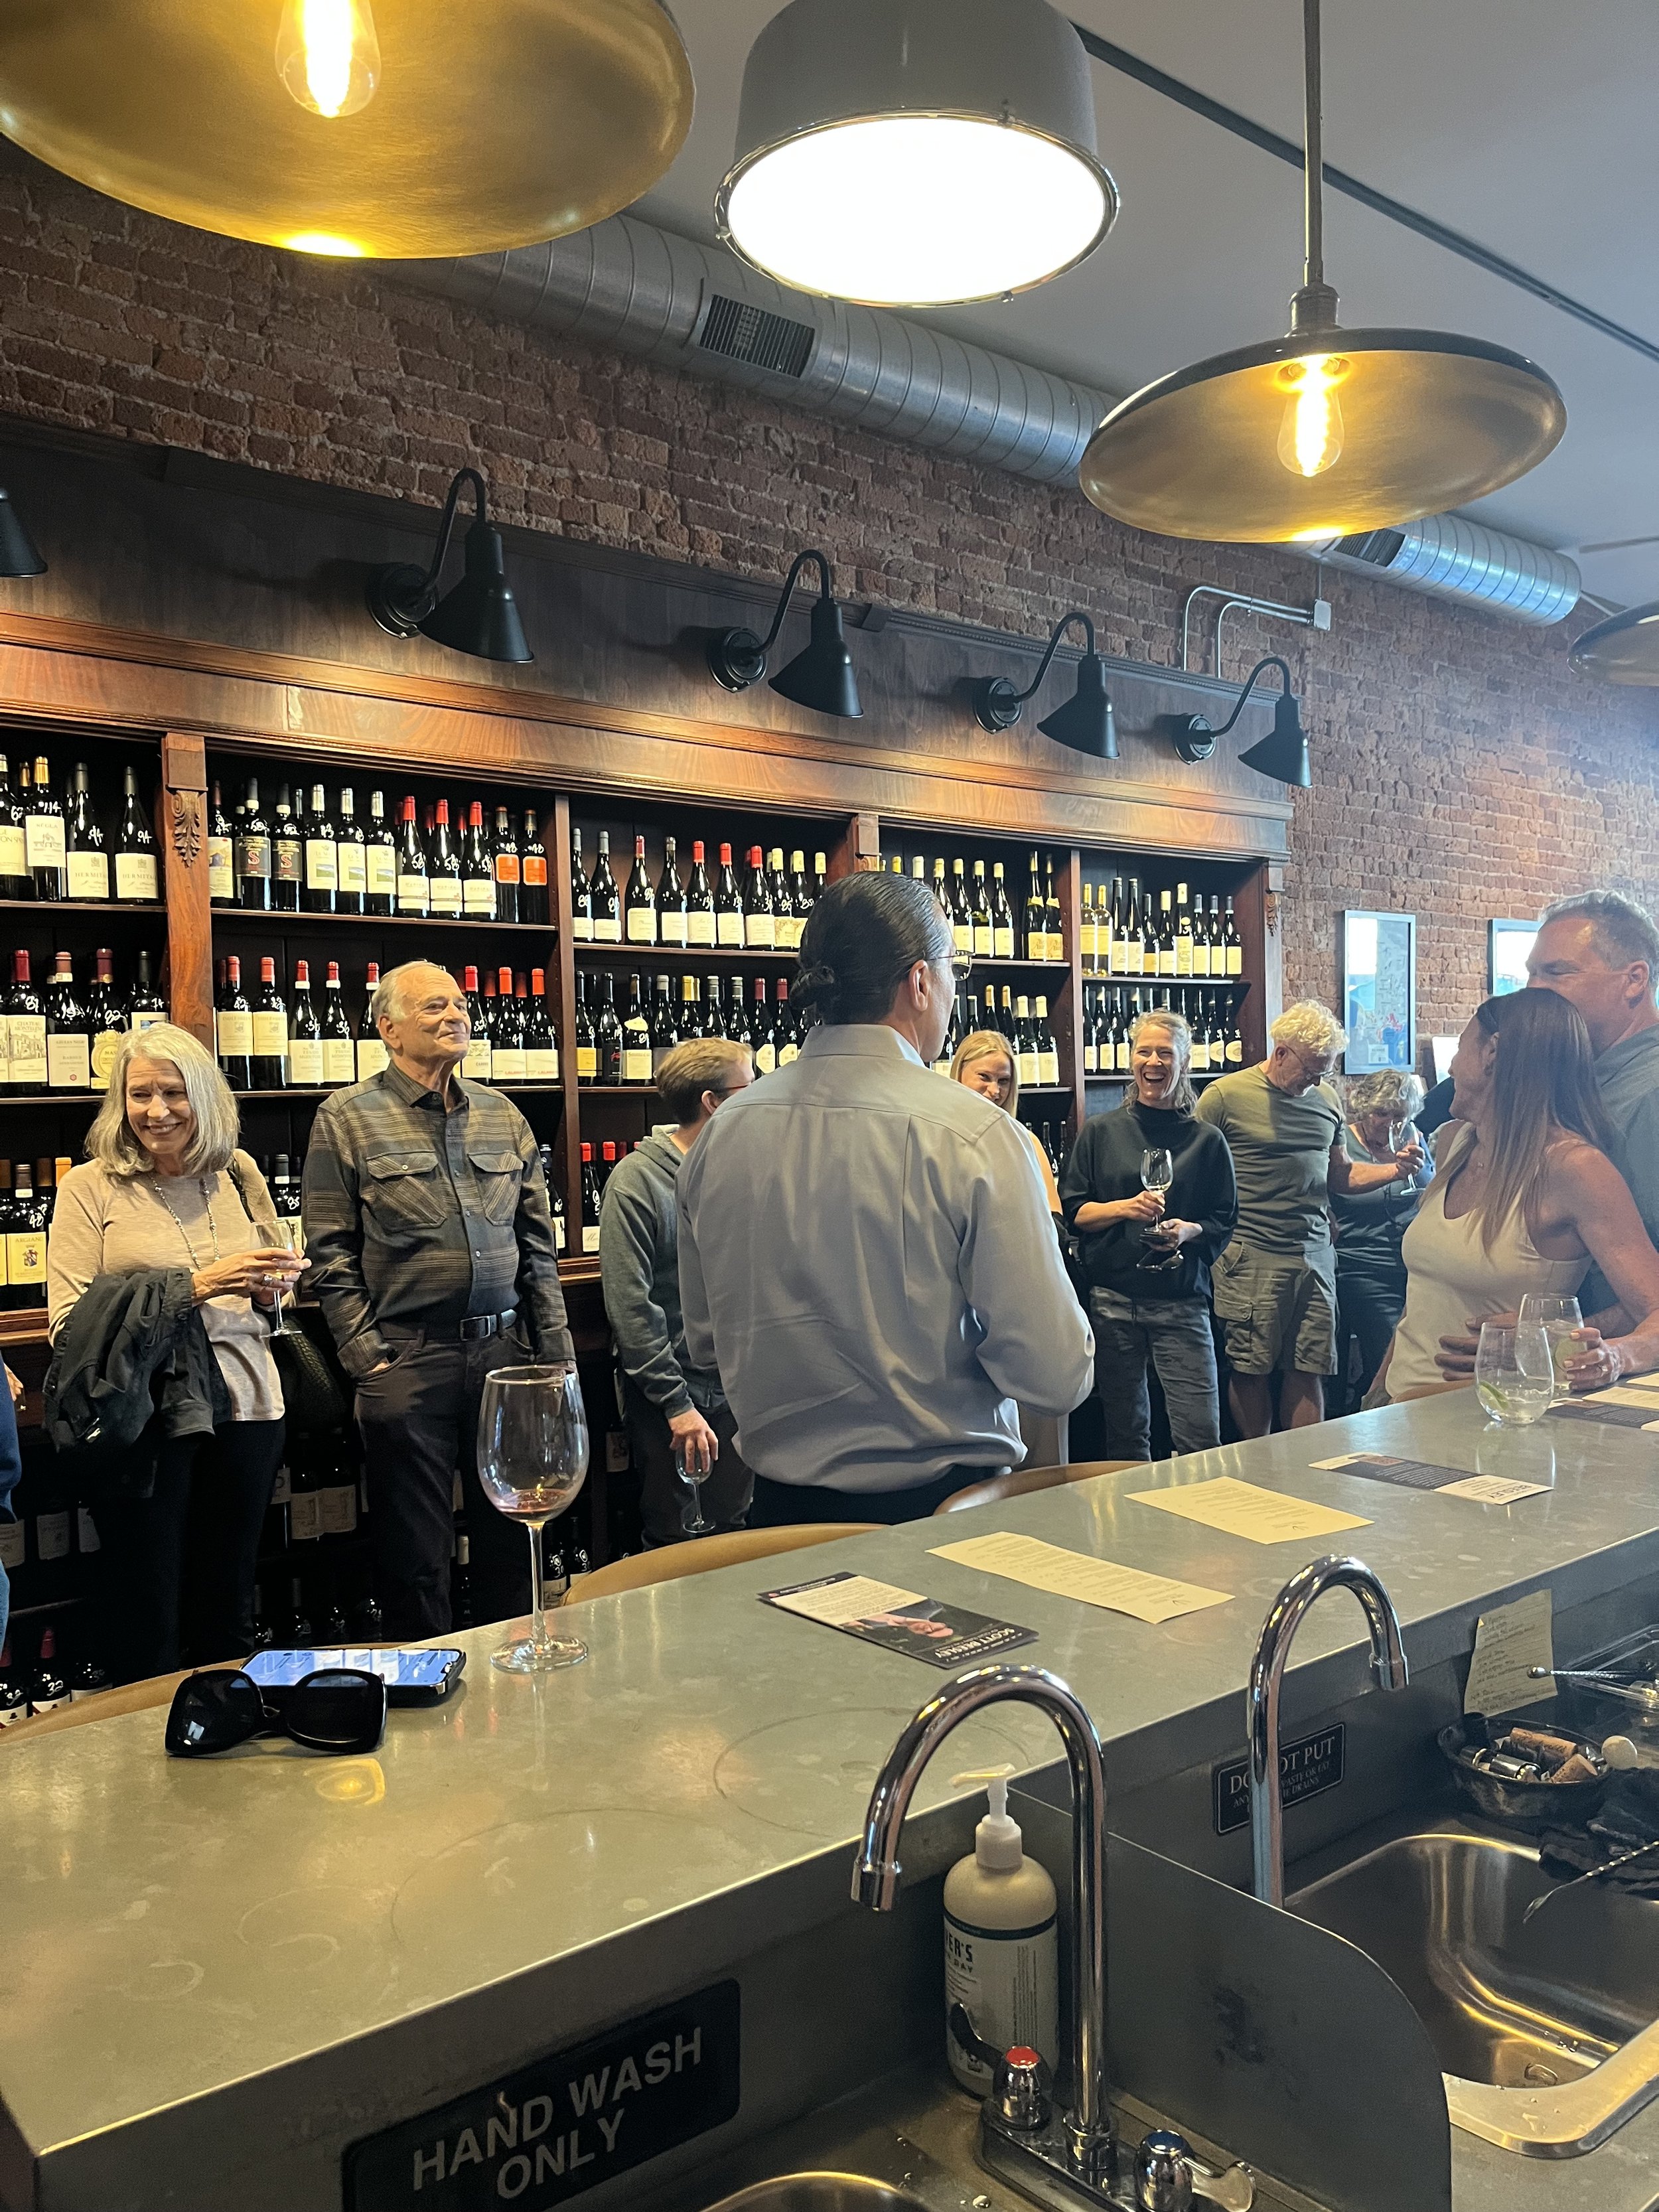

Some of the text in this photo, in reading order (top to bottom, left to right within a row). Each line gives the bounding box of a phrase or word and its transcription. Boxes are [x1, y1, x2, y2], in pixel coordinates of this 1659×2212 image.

[46, 1680, 64, 1696] 32
[1304, 1736, 1335, 1765] PUT
[413, 2027, 702, 2191] HAND WASH
[496, 2109, 625, 2200] ONLY
